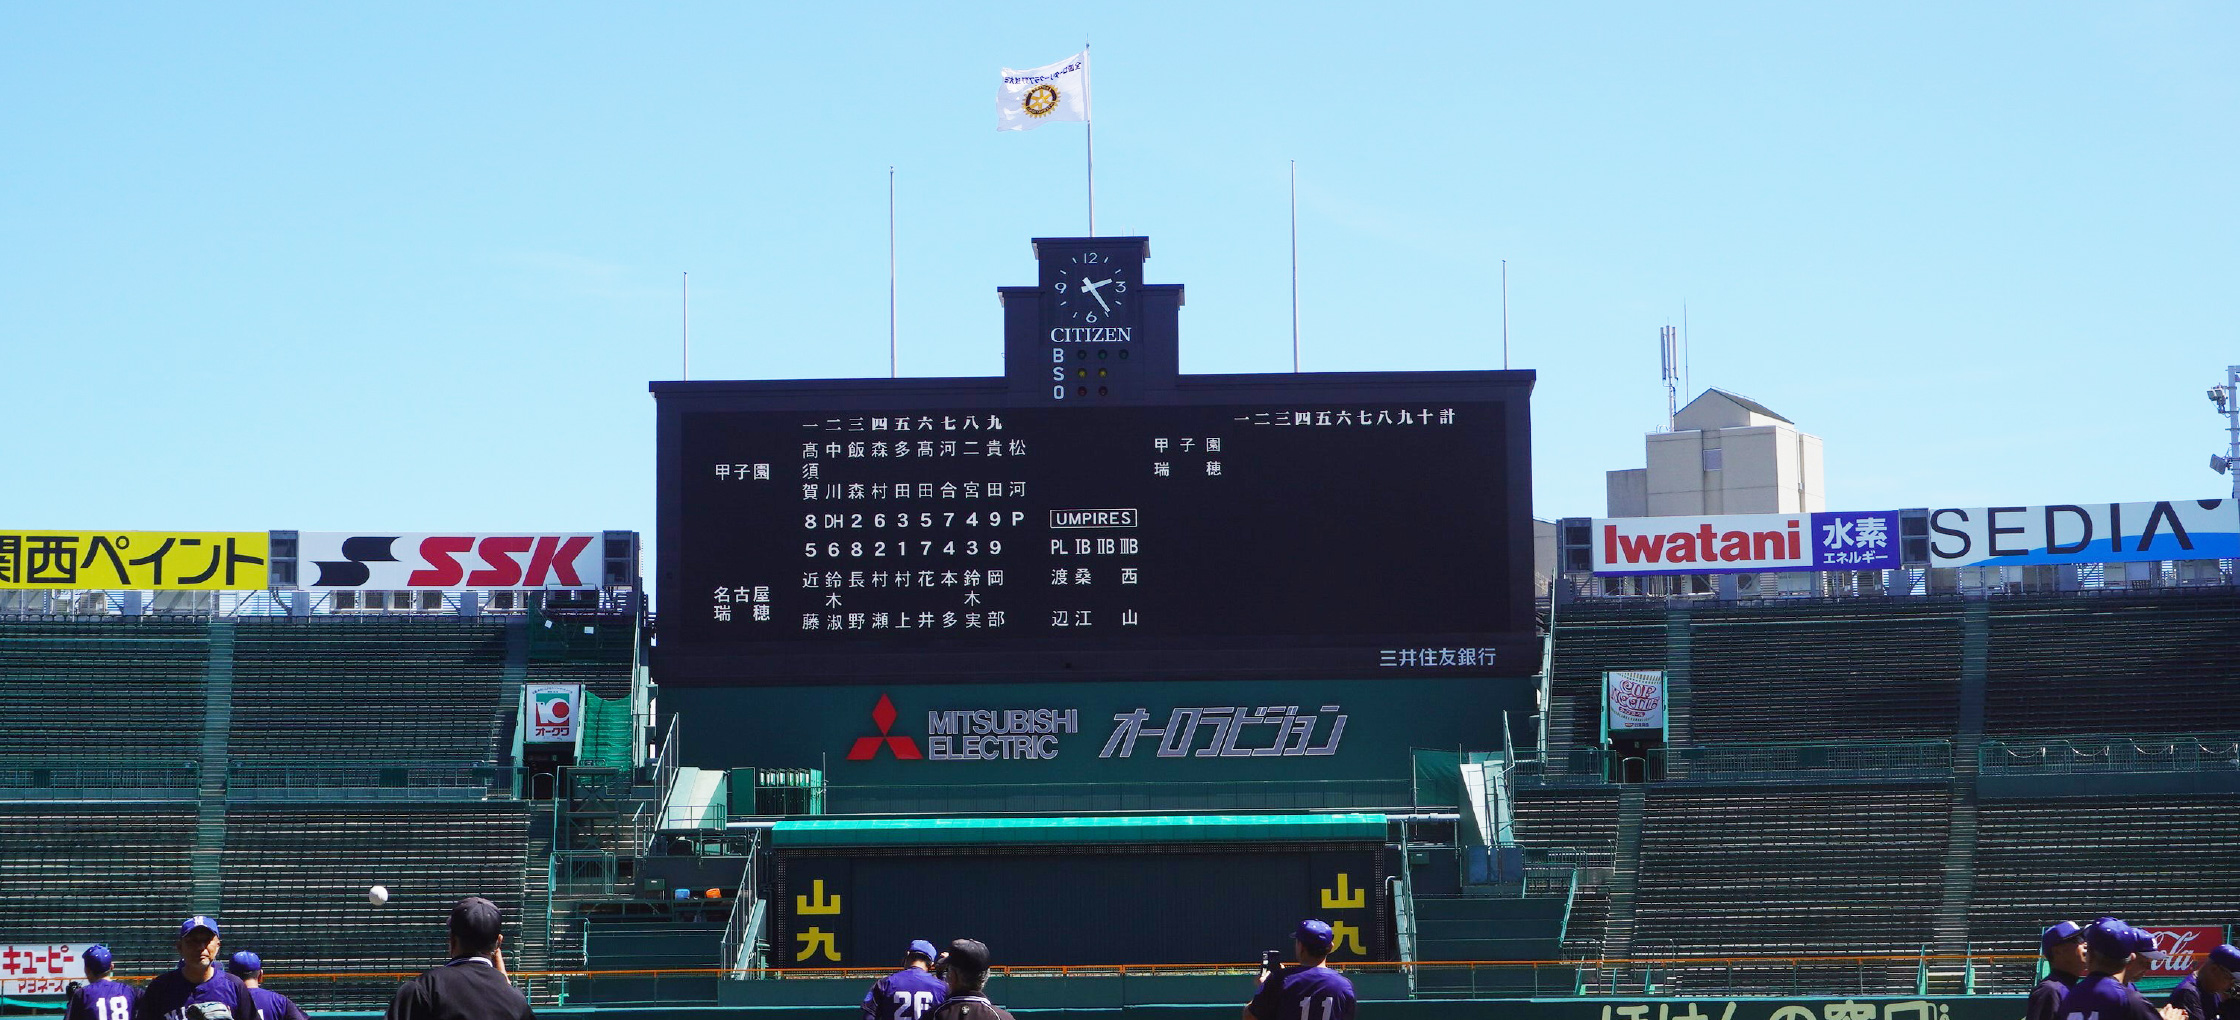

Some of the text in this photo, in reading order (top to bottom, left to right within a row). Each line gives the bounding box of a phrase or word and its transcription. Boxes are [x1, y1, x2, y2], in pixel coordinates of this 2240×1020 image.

[1084, 253, 1098, 264] 12
[1055, 282, 1067, 294] 9
[1115, 282, 1126, 293] 3
[1085, 311, 1097, 323] 6
[1050, 328, 1132, 343] CITIZEN
[1053, 348, 1064, 363] B
[1053, 367, 1064, 381] S
[1154, 437, 1221, 454] 甲子園
[715, 463, 770, 481] 甲子園
[804, 511, 1025, 530] 8 DH 2 6 3 5 7 4 9 P
[1056, 512, 1131, 526] UMPIRES
[1604, 520, 1801, 564] Iwatani
[1822, 517, 1887, 549] 水素
[804, 540, 1002, 557] 5 6 8 2 1 7 4 3 9
[1051, 539, 1068, 555] PL
[407, 537, 593, 586] SSK
[1823, 550, 1888, 564] エネルギー
[713, 585, 770, 603] 名古屋
[1379, 647, 1497, 667] 三井住友銀行
[1620, 680, 1656, 698] CUP
[928, 709, 1078, 734] MITSUBISHI
[1099, 705, 1348, 758] オーロラビジョン
[928, 736, 1059, 760] ELECTRIC
[796, 879, 841, 962] 山九
[1321, 873, 1367, 955] 山九
[2, 944, 75, 975] キューピー
[96, 996, 130, 1020] 18
[1299, 996, 1334, 1020] 11
